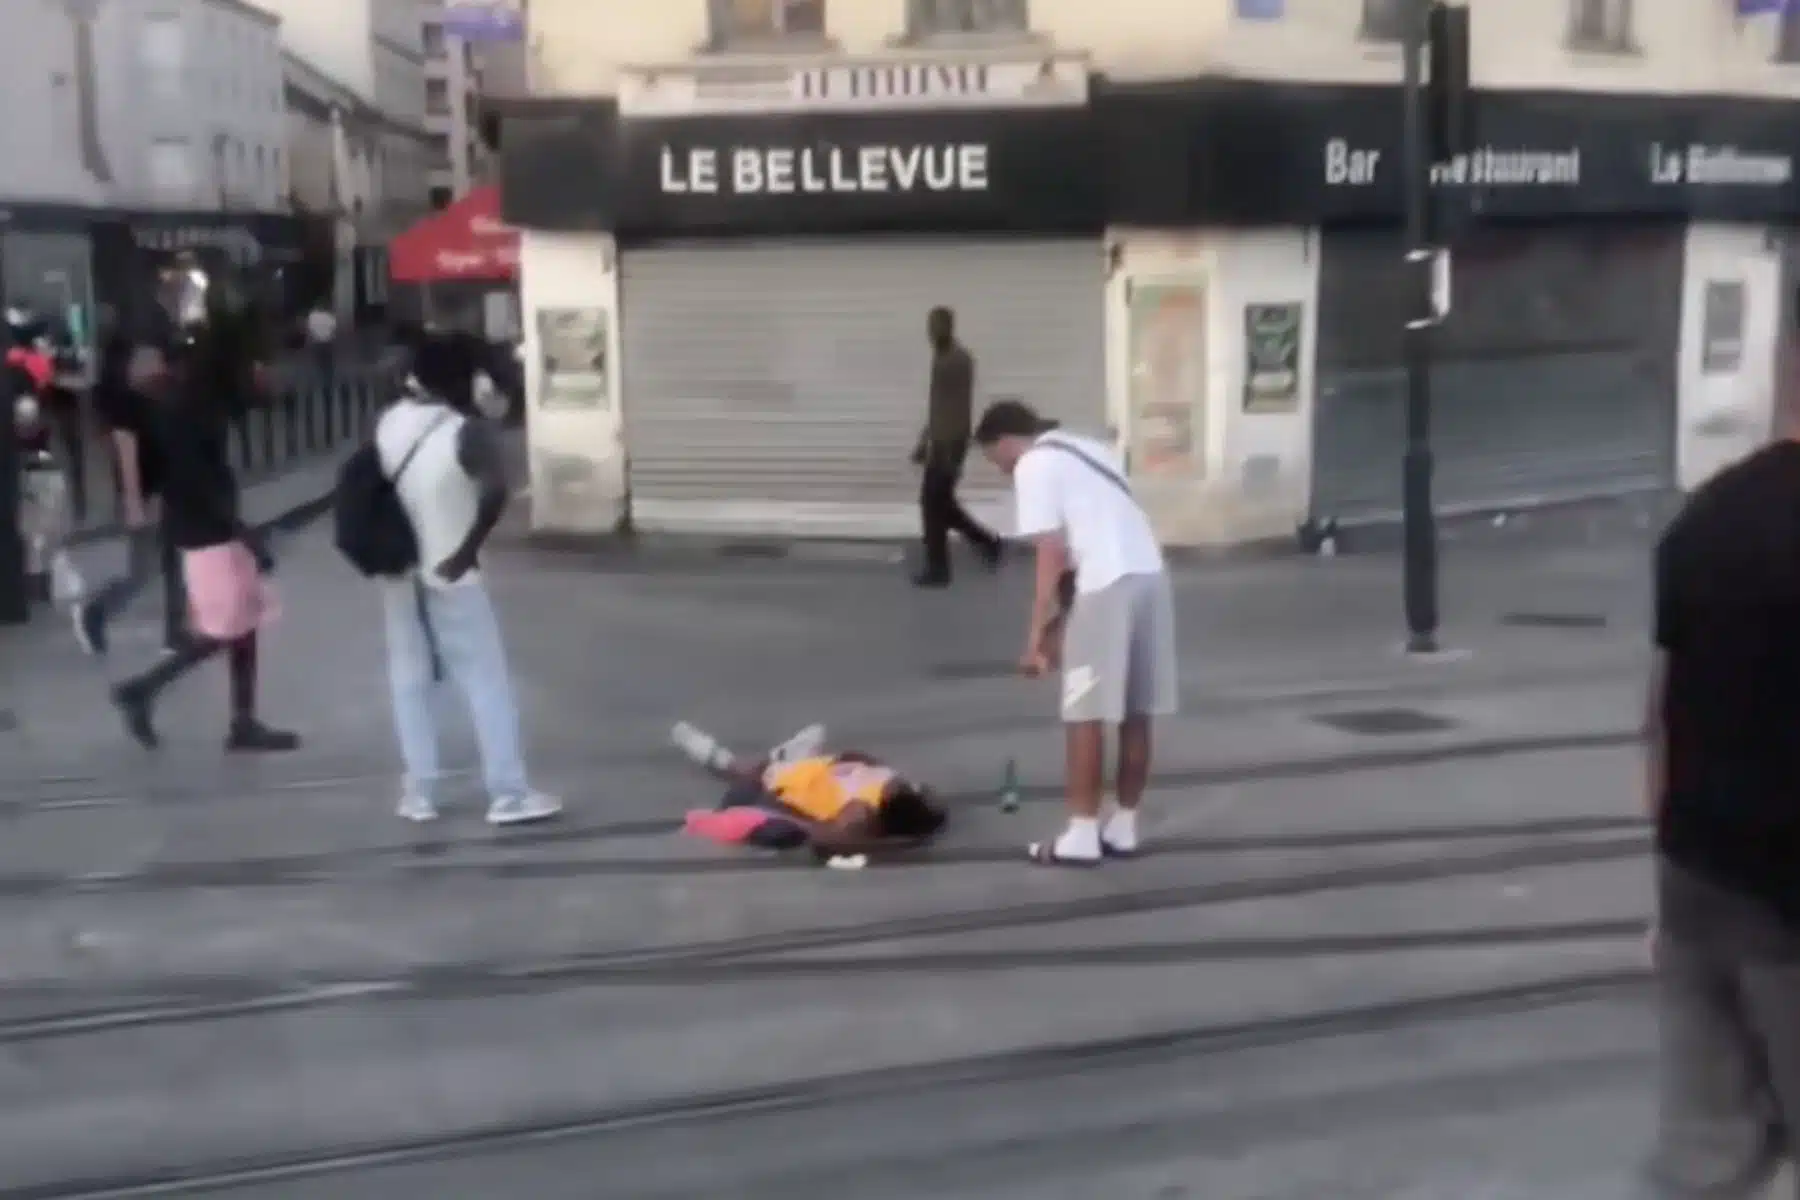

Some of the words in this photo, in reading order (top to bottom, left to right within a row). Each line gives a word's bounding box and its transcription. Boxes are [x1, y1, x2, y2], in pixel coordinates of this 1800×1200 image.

[660, 146, 718, 192] LE
[732, 145, 988, 193] BELLEVUE
[1325, 139, 1379, 184] Bar
